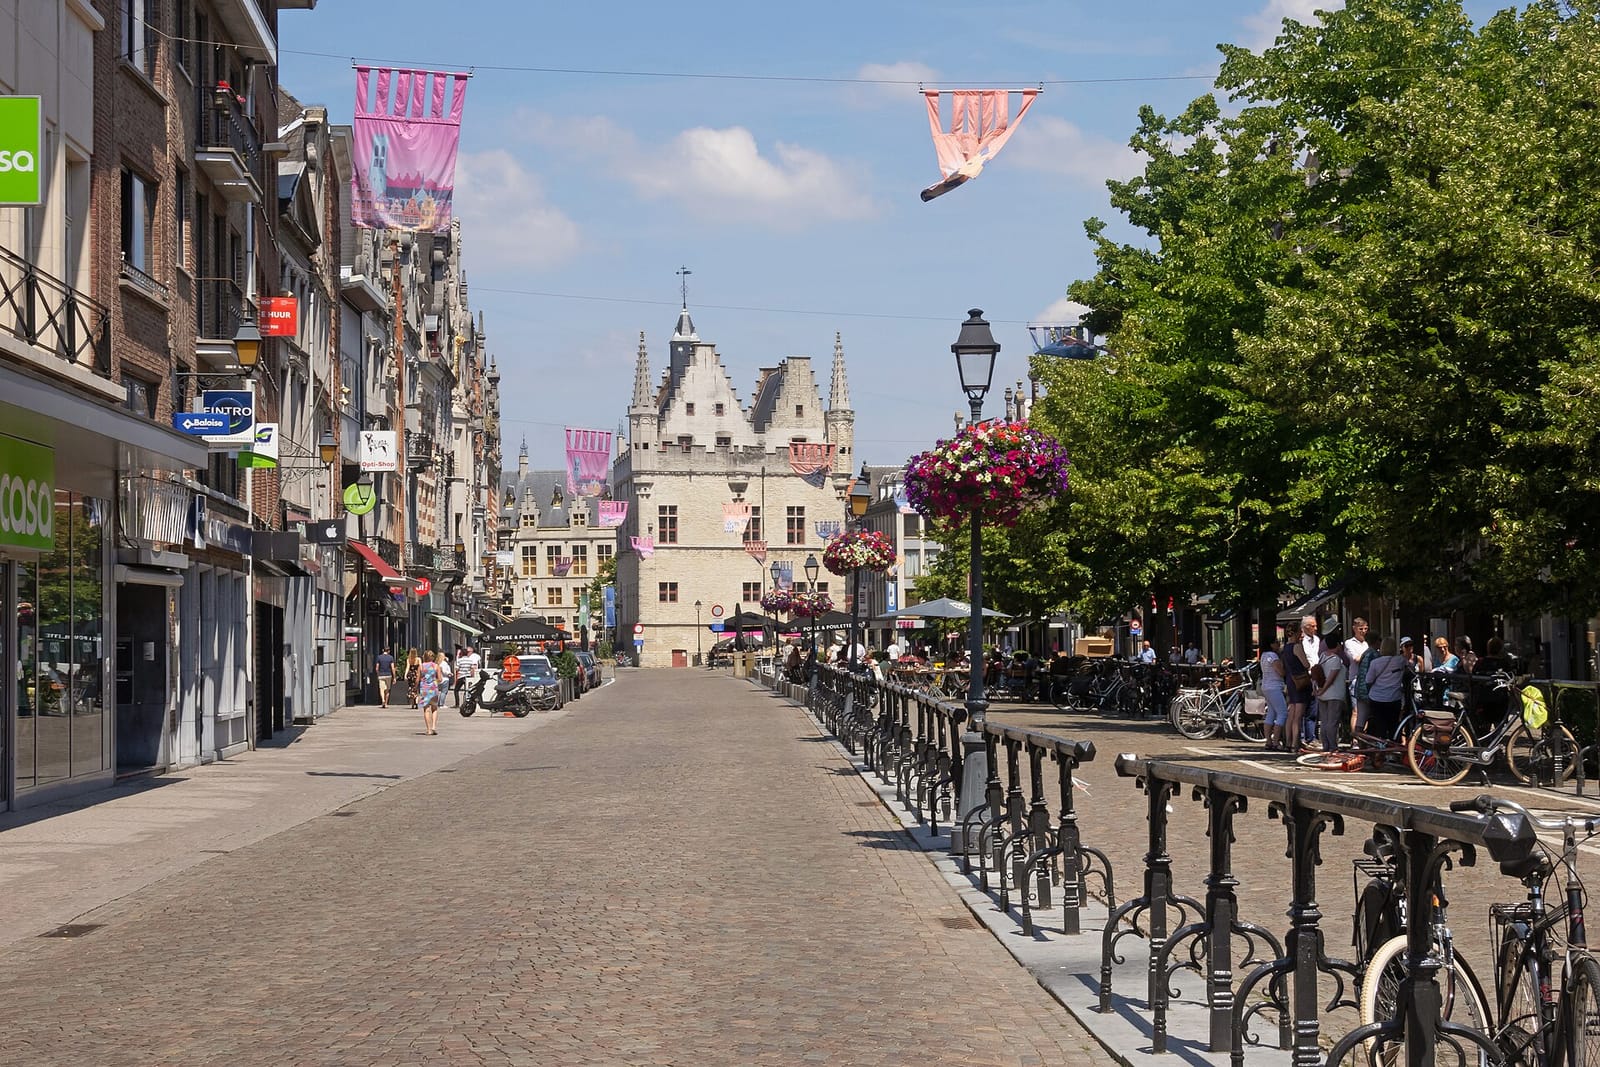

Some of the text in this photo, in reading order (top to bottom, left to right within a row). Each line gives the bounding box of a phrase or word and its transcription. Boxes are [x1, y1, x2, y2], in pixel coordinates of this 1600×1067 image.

[268, 311, 291, 319] HUUR
[203, 406, 252, 417] FINTRO
[193, 418, 224, 427] Baloise
[0, 473, 52, 539] casa
